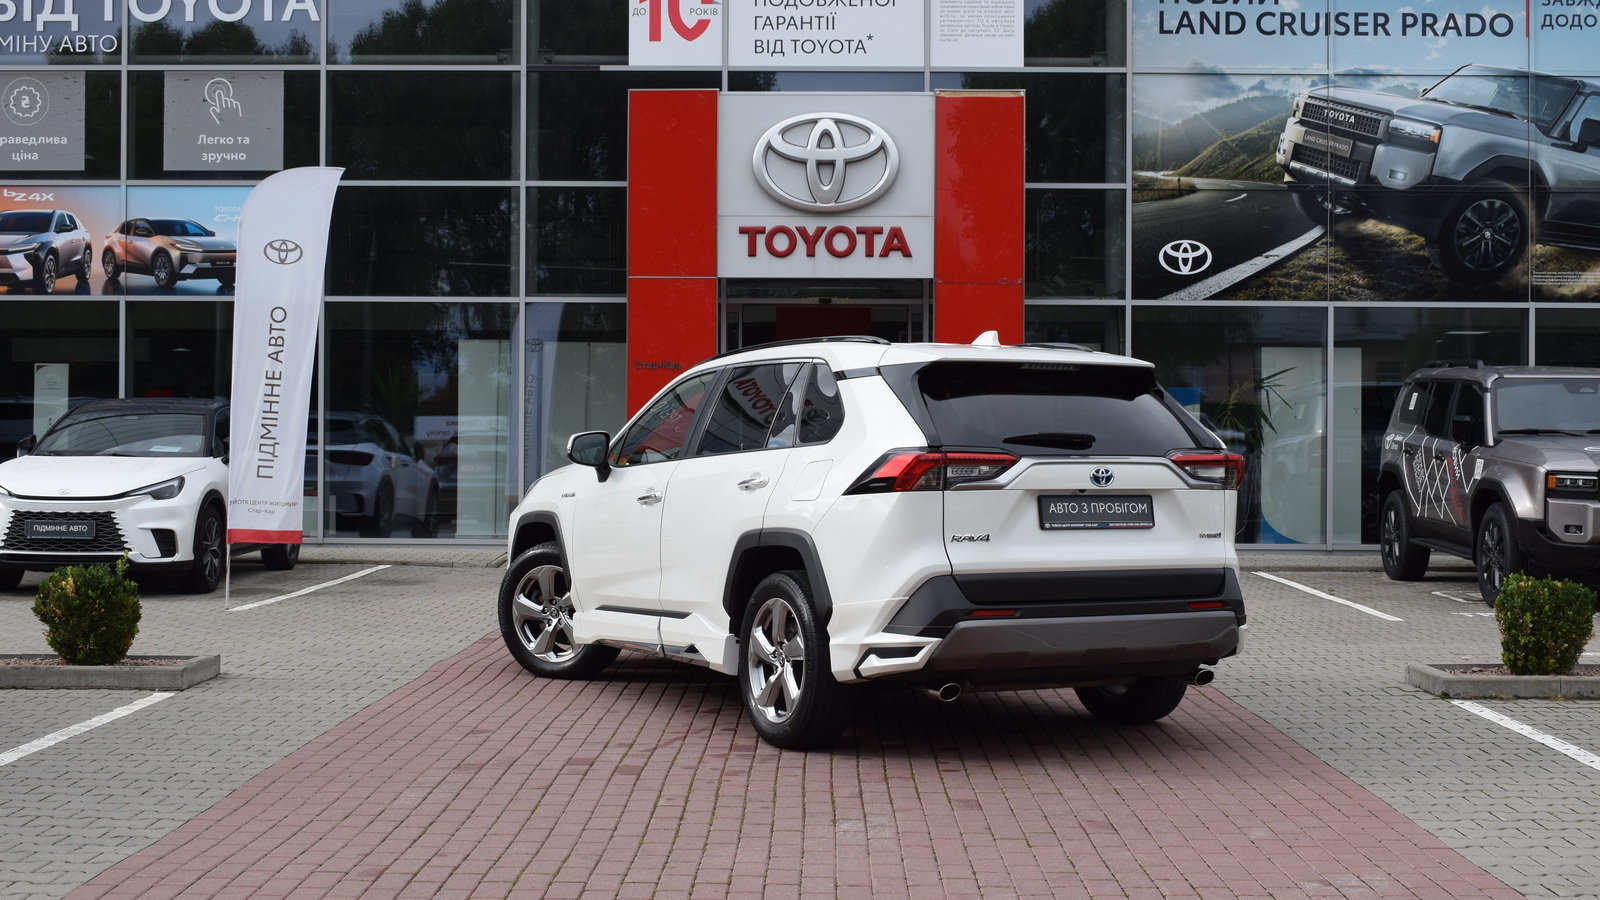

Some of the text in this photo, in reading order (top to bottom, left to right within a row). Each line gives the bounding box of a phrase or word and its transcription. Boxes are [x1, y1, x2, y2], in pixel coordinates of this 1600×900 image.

[632, 8, 647, 16] ДО
[689, 8, 718, 16] РОКІВ
[754, 12, 837, 31] ГАРАНТІЇ
[1159, 10, 1514, 38] LAND CRUISER PRADO
[59, 35, 118, 52] АВТО
[754, 39, 785, 57] ВІД
[1324, 109, 1355, 123] TOYOTA
[198, 134, 250, 145] Легко та
[12, 150, 39, 162] ціна
[201, 152, 247, 163] зручно
[739, 225, 913, 258] TOYOTA
[634, 361, 682, 370] Стар-Кар
[256, 306, 287, 479] ПІДМІННЕ АВТО
[1049, 503, 1148, 514] АВТО З ПРОБІГОМ
[33, 524, 67, 532] ПІДМІННЕ
[950, 534, 990, 542] RAV4
